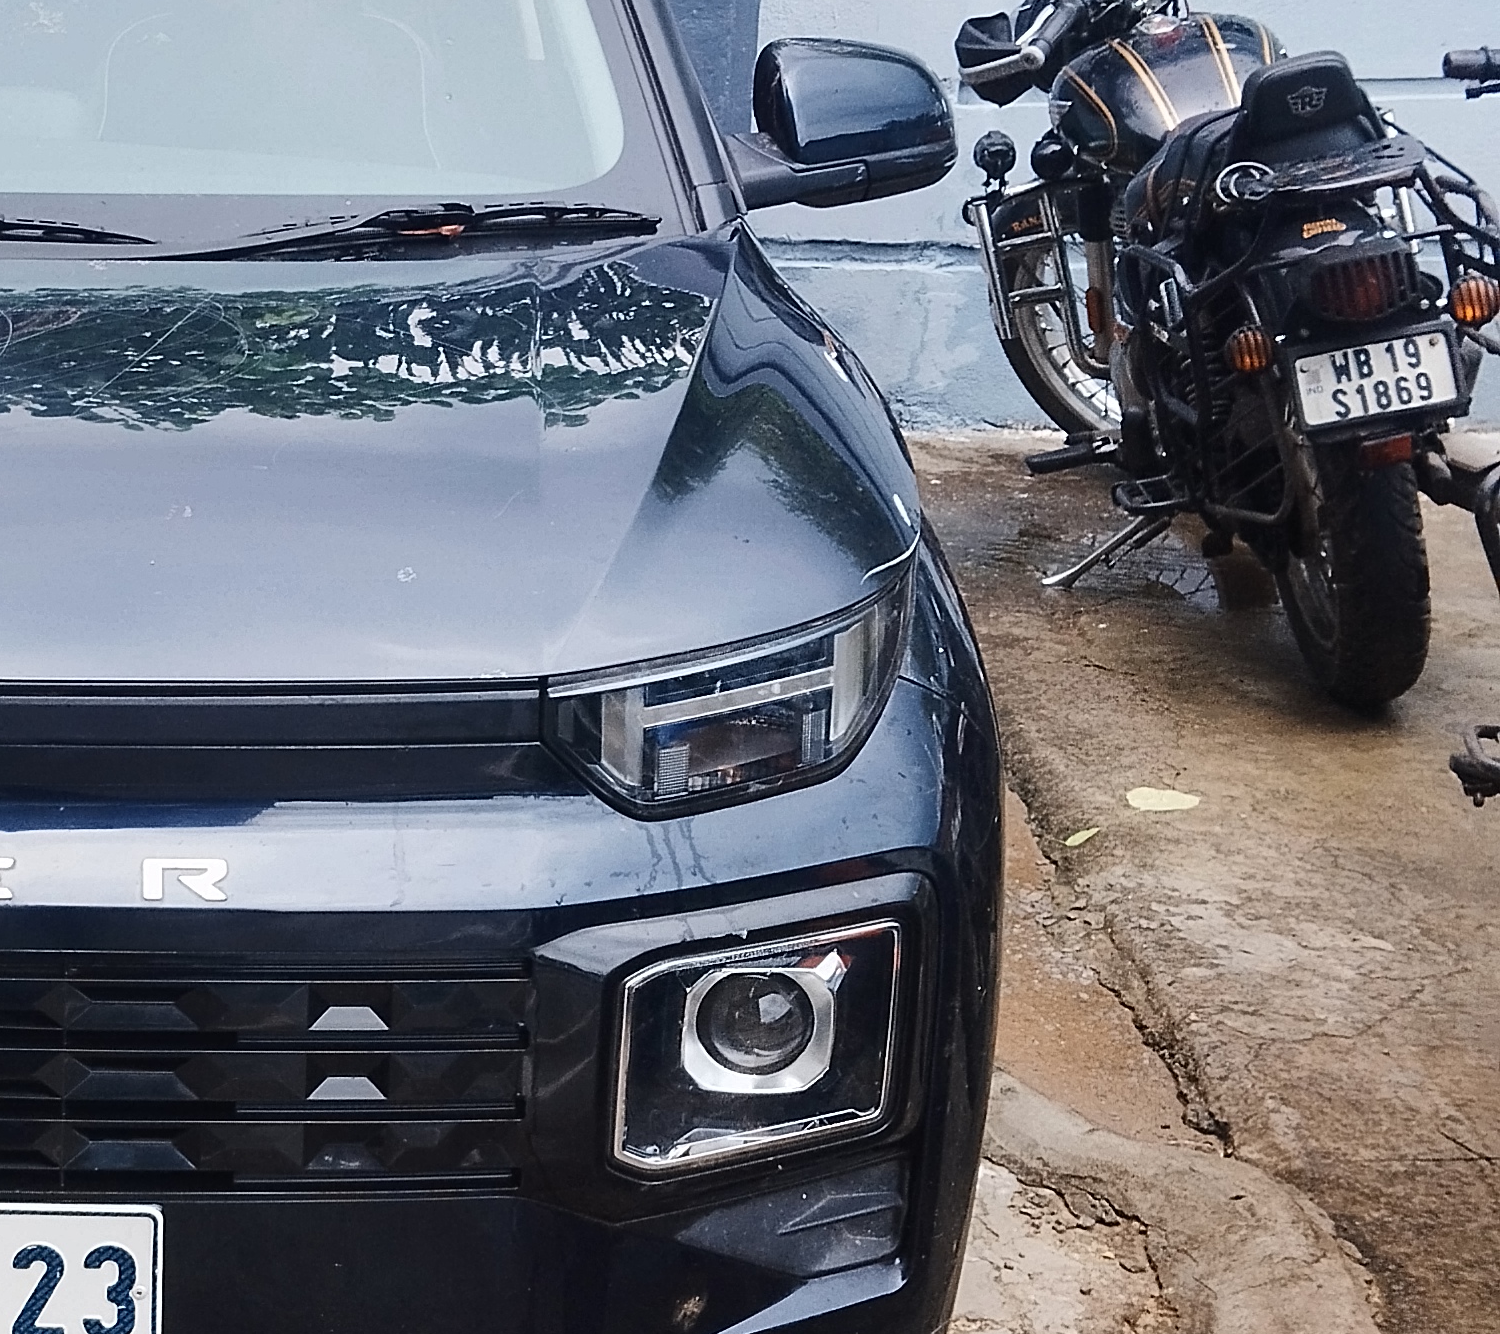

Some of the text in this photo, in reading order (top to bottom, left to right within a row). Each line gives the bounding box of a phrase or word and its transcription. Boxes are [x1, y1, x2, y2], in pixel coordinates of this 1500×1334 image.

[1329, 338, 1421, 384] WB 19
[1332, 372, 1433, 418] S1869
